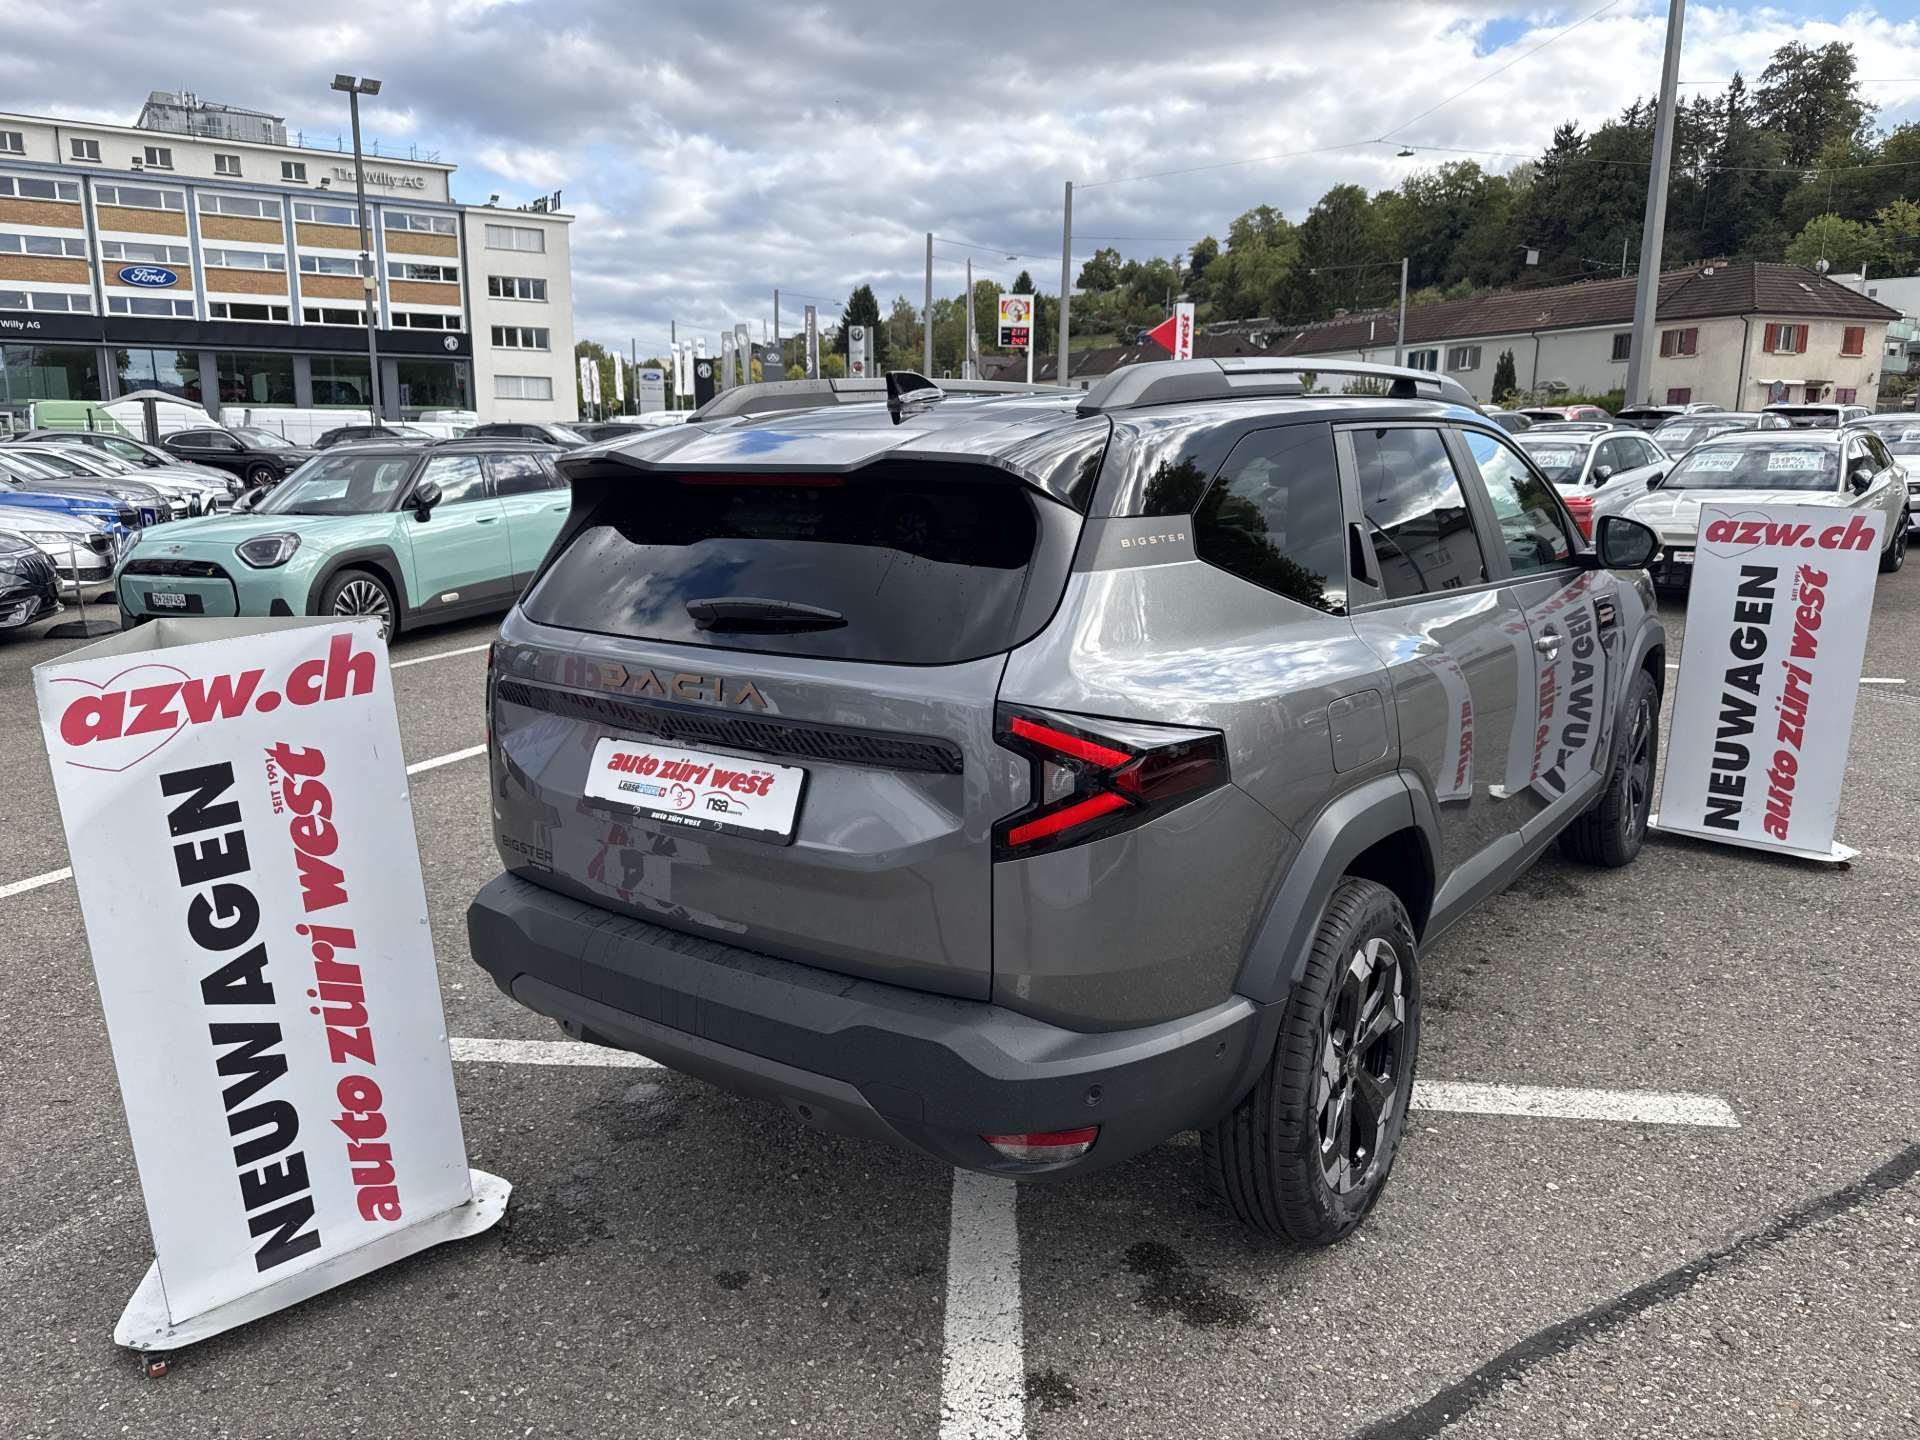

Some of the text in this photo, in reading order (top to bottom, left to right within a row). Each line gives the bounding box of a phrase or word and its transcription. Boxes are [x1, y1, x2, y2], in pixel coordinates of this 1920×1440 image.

[363, 168, 399, 188] Willy
[402, 174, 425, 189] AG
[131, 266, 166, 284] Ford
[1703, 267, 1714, 276] 48
[0, 319, 41, 330] Willy AG
[1120, 533, 1186, 549] BIGSTER
[1705, 516, 1876, 551] azw.ch
[60, 633, 376, 746] azw.ch
[601, 663, 768, 708] DACIA
[1703, 565, 1778, 831] NEUWAGEN
[1763, 563, 1829, 841] auto züri west
[265, 758, 284, 815] SEIT 1991
[607, 752, 776, 797] auto züri west
[651, 812, 702, 827] auto züri west
[706, 798, 729, 813] nsa
[502, 834, 553, 864] BIGSTER
[264, 741, 403, 1222] auto züri west
[160, 761, 321, 1274] NEUWAGEN
